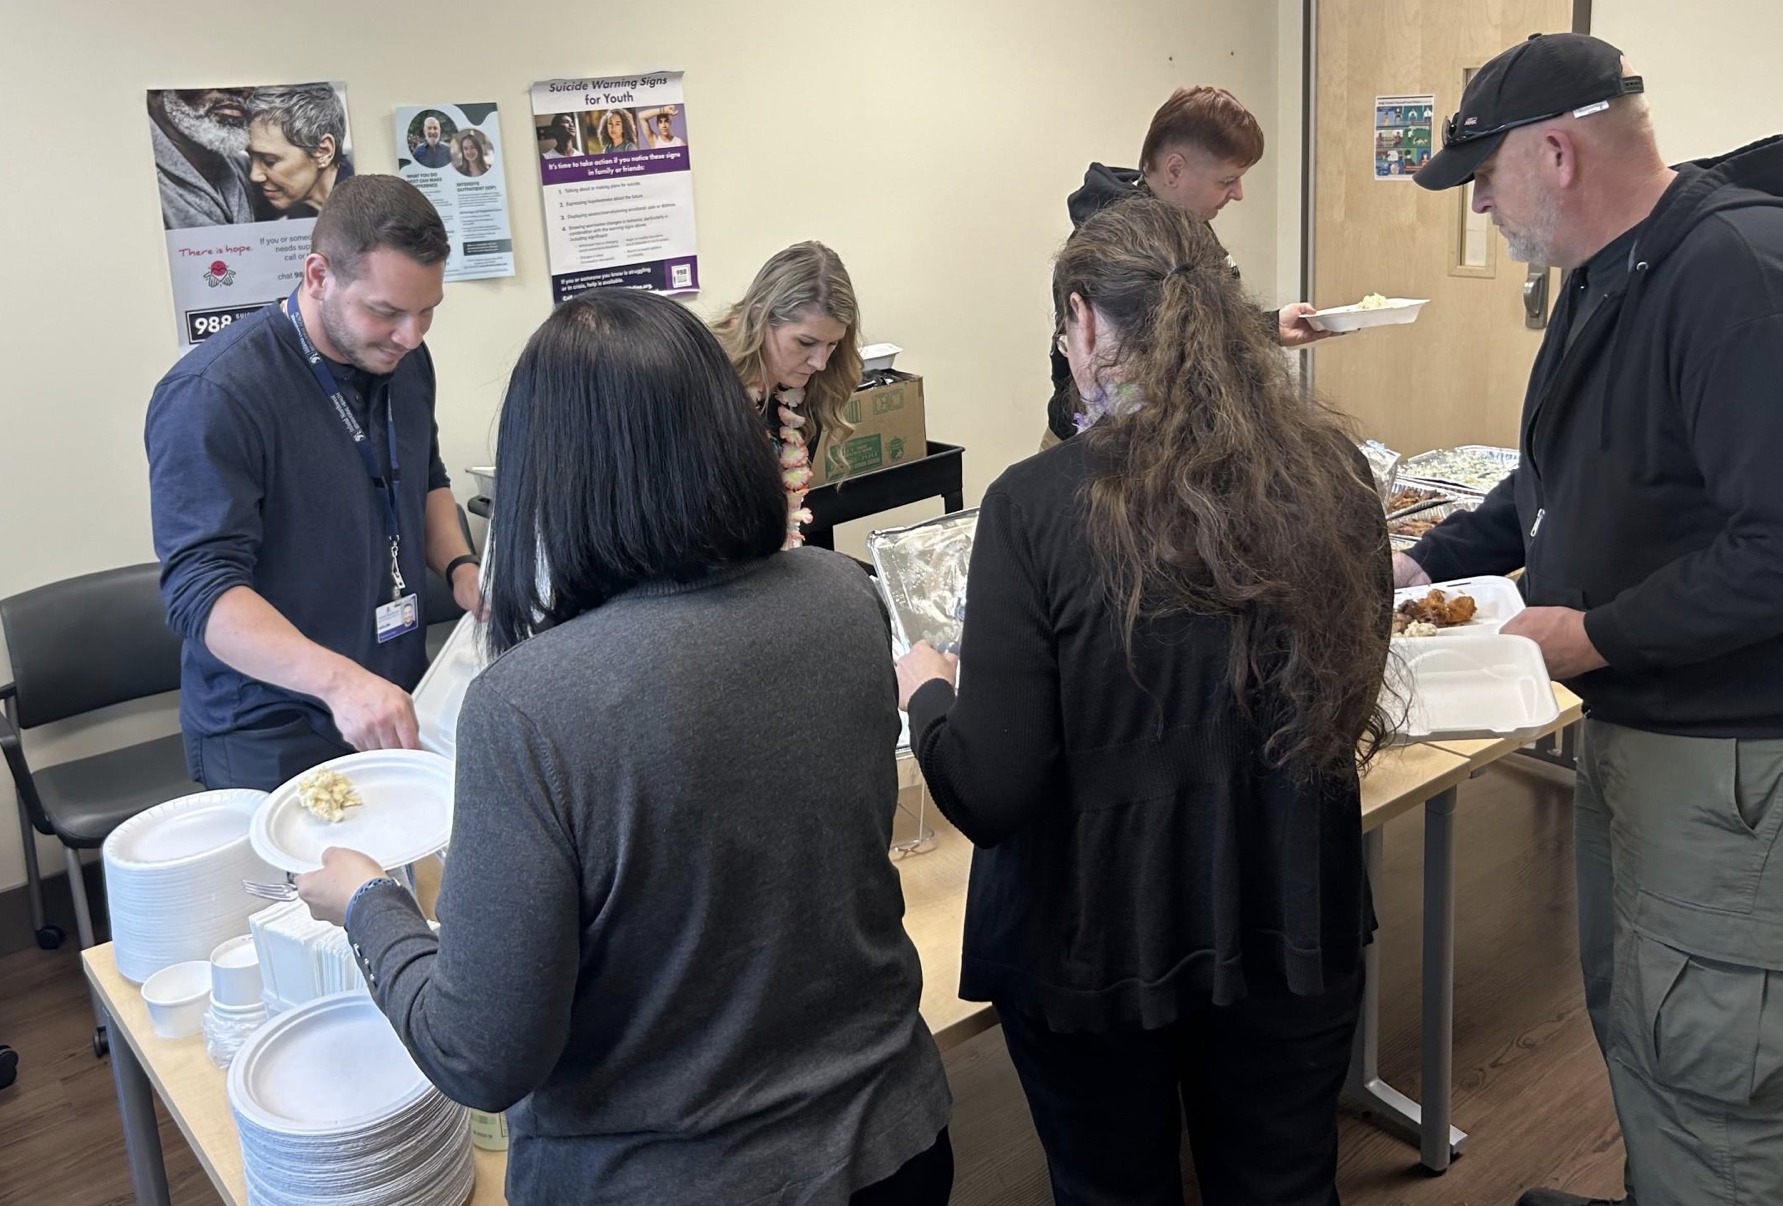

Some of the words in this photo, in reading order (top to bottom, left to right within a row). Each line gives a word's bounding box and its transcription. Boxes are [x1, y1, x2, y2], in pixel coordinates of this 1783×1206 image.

[549, 82, 588, 92] Suicide
[592, 78, 638, 90] Warning
[640, 77, 668, 88] Signs
[584, 94, 600, 106] for
[603, 91, 634, 104] Youth
[666, 152, 681, 160] signs
[595, 167, 614, 176] family
[179, 248, 213, 257] There
[195, 315, 232, 335] 988
